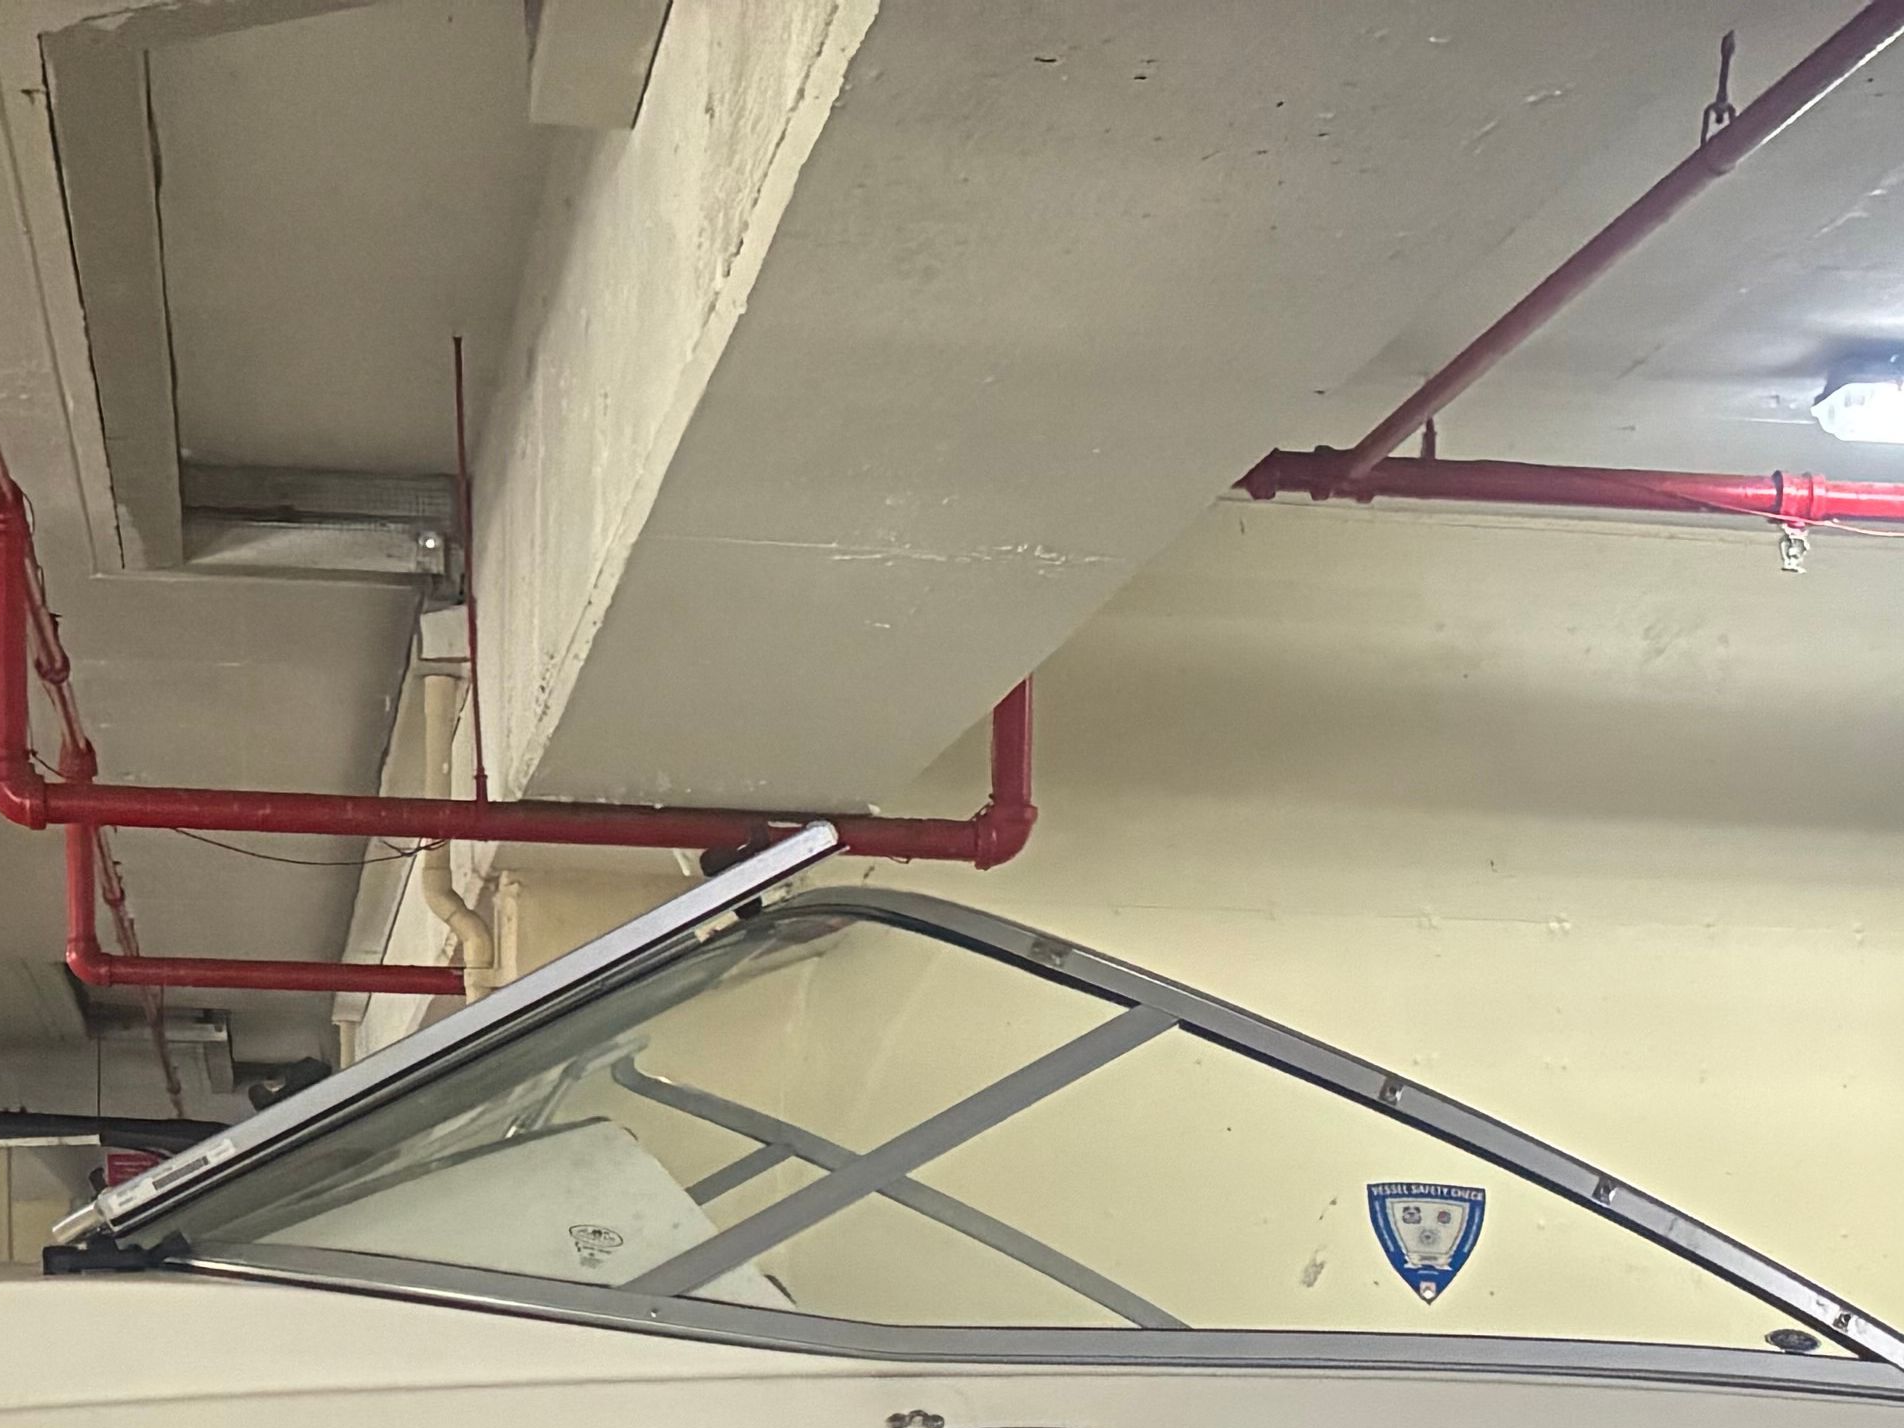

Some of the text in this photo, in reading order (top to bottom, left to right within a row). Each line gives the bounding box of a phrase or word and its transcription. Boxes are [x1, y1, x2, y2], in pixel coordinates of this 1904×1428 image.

[1371, 1184, 1484, 1201] VESSEL SAFETY CHECK
